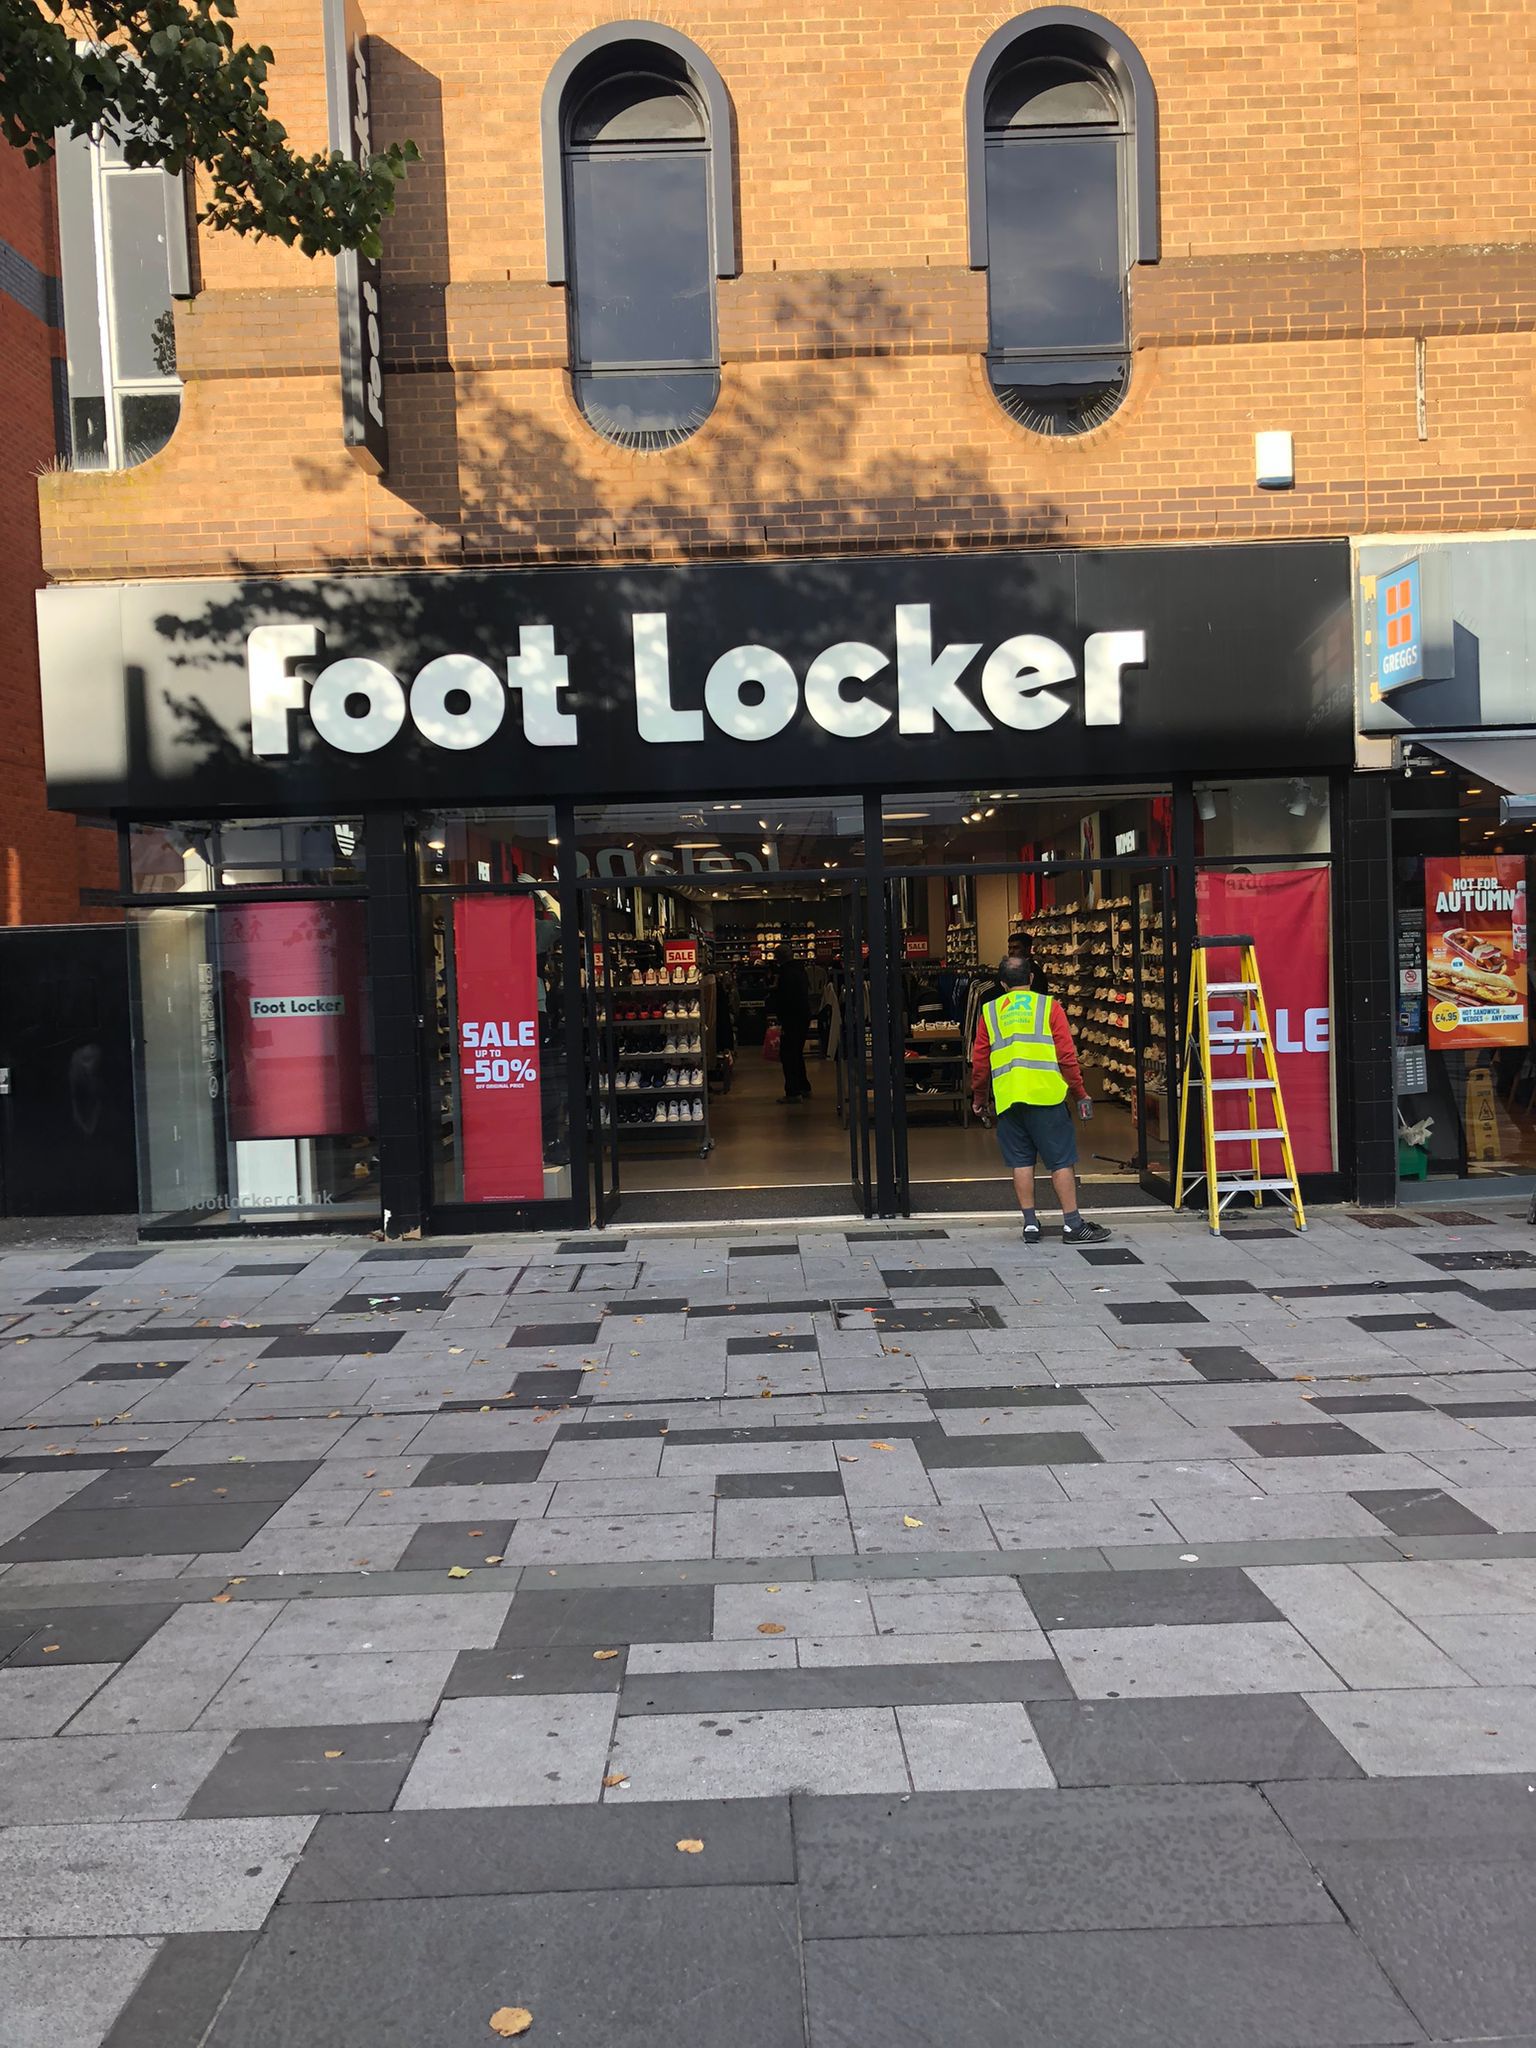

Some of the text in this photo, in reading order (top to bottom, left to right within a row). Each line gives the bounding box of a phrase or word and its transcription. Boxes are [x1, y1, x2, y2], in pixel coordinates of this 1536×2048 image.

[1382, 645, 1418, 674] GREGGS
[247, 603, 1146, 756] Foot Locker
[1453, 877, 1498, 891] HOT FOR
[1435, 889, 1516, 913] AUTUMN
[908, 942, 926, 950] SALE
[668, 952, 694, 961] SALE
[1452, 960, 1463, 968] NEW
[253, 999, 341, 1015] Foot Locker
[1435, 1012, 1458, 1023] £4.95
[462, 1021, 536, 1048] SALE
[475, 1050, 488, 1058] UP
[463, 1059, 537, 1083] -50%
